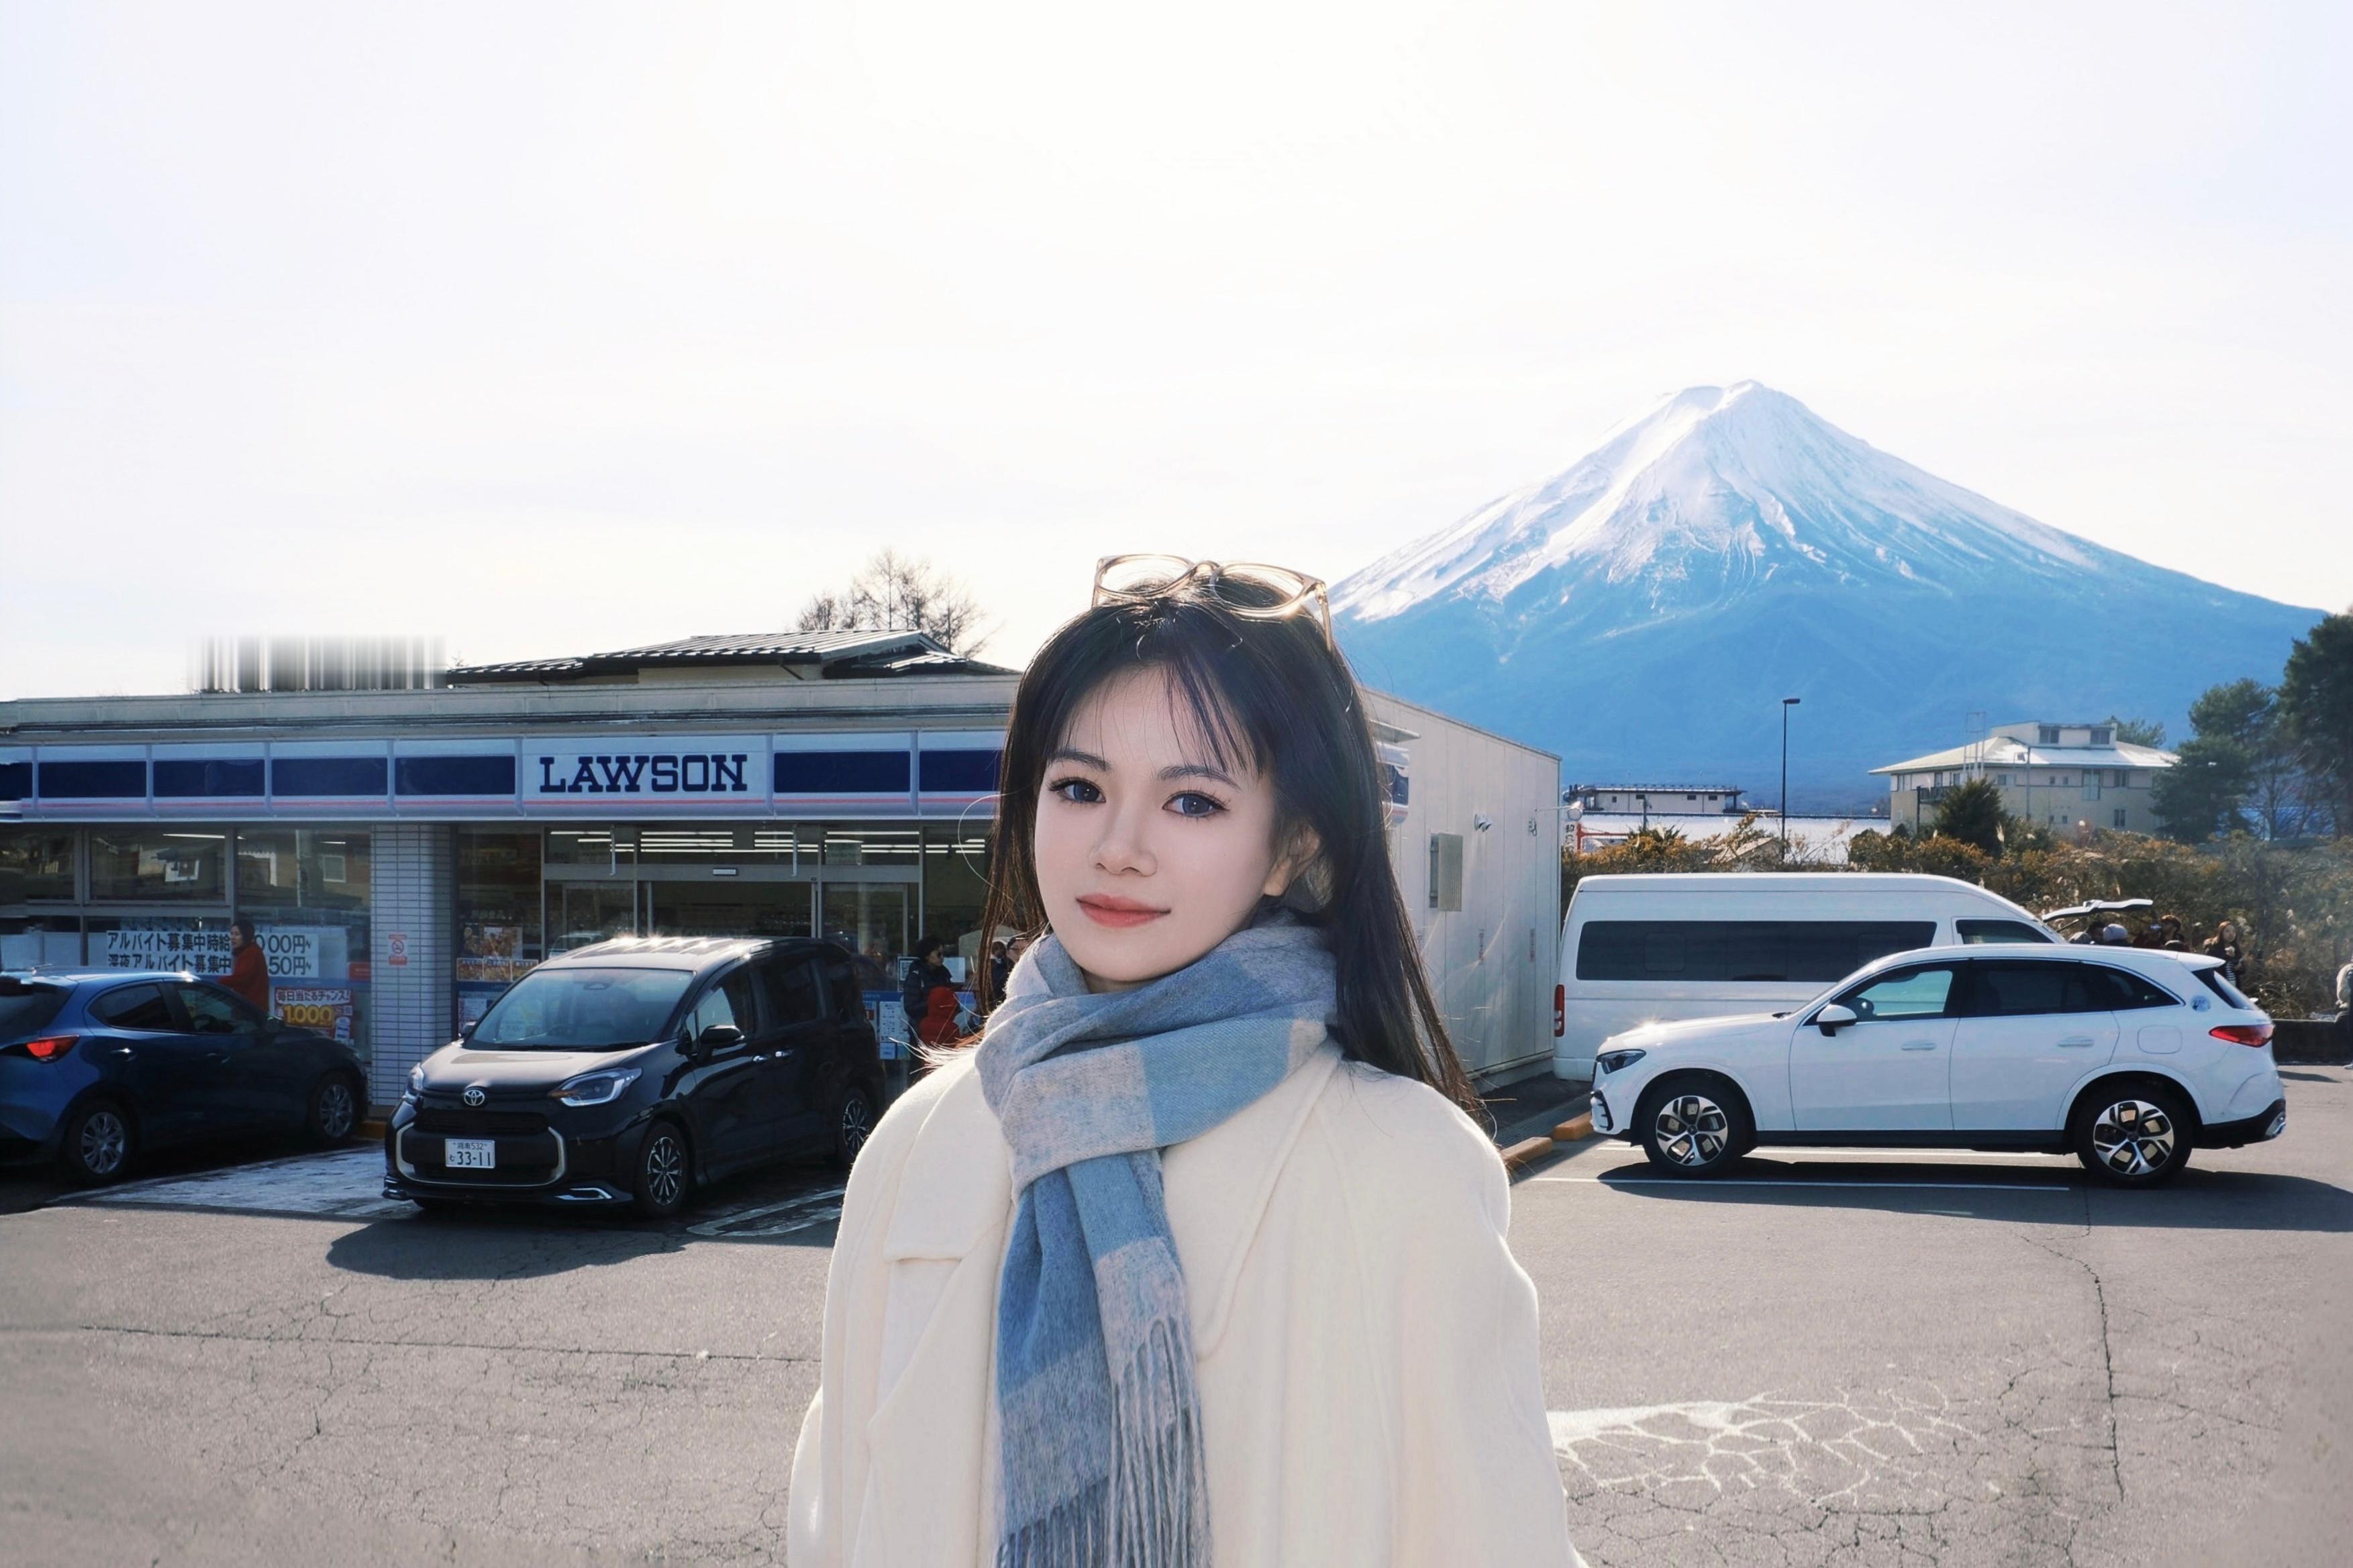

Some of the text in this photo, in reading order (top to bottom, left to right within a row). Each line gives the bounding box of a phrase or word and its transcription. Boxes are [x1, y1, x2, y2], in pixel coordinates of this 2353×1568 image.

[540, 754, 748, 793] LAWSON
[107, 932, 230, 952] アルバイト募集中時給
[457, 1151, 491, 1166] 33-11
